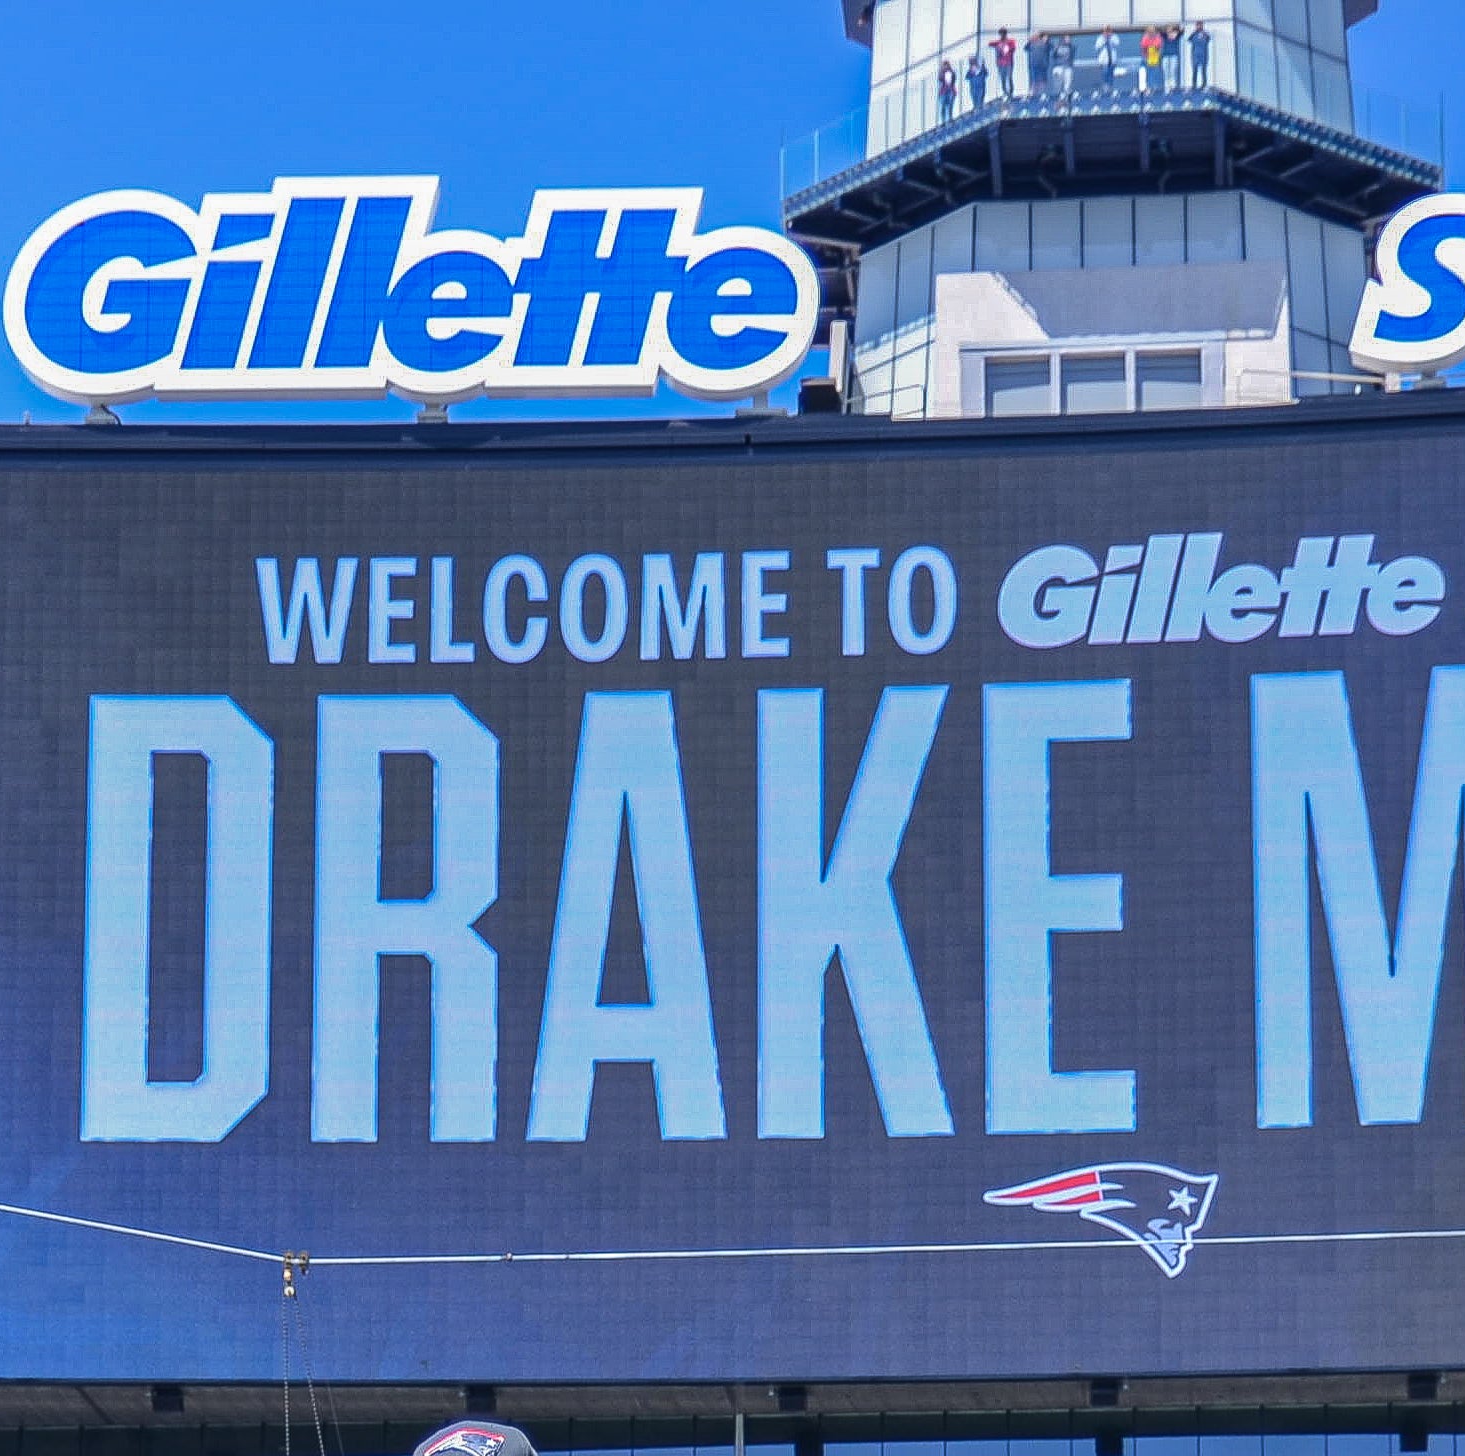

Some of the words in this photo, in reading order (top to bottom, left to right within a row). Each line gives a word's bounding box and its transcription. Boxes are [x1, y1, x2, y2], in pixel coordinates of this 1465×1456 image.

[22, 190, 802, 376] Gillette
[254, 549, 791, 665] WELCOME
[826, 544, 960, 656] TO
[996, 532, 1446, 649] Gillette
[78, 677, 1138, 1144] DRAKE
